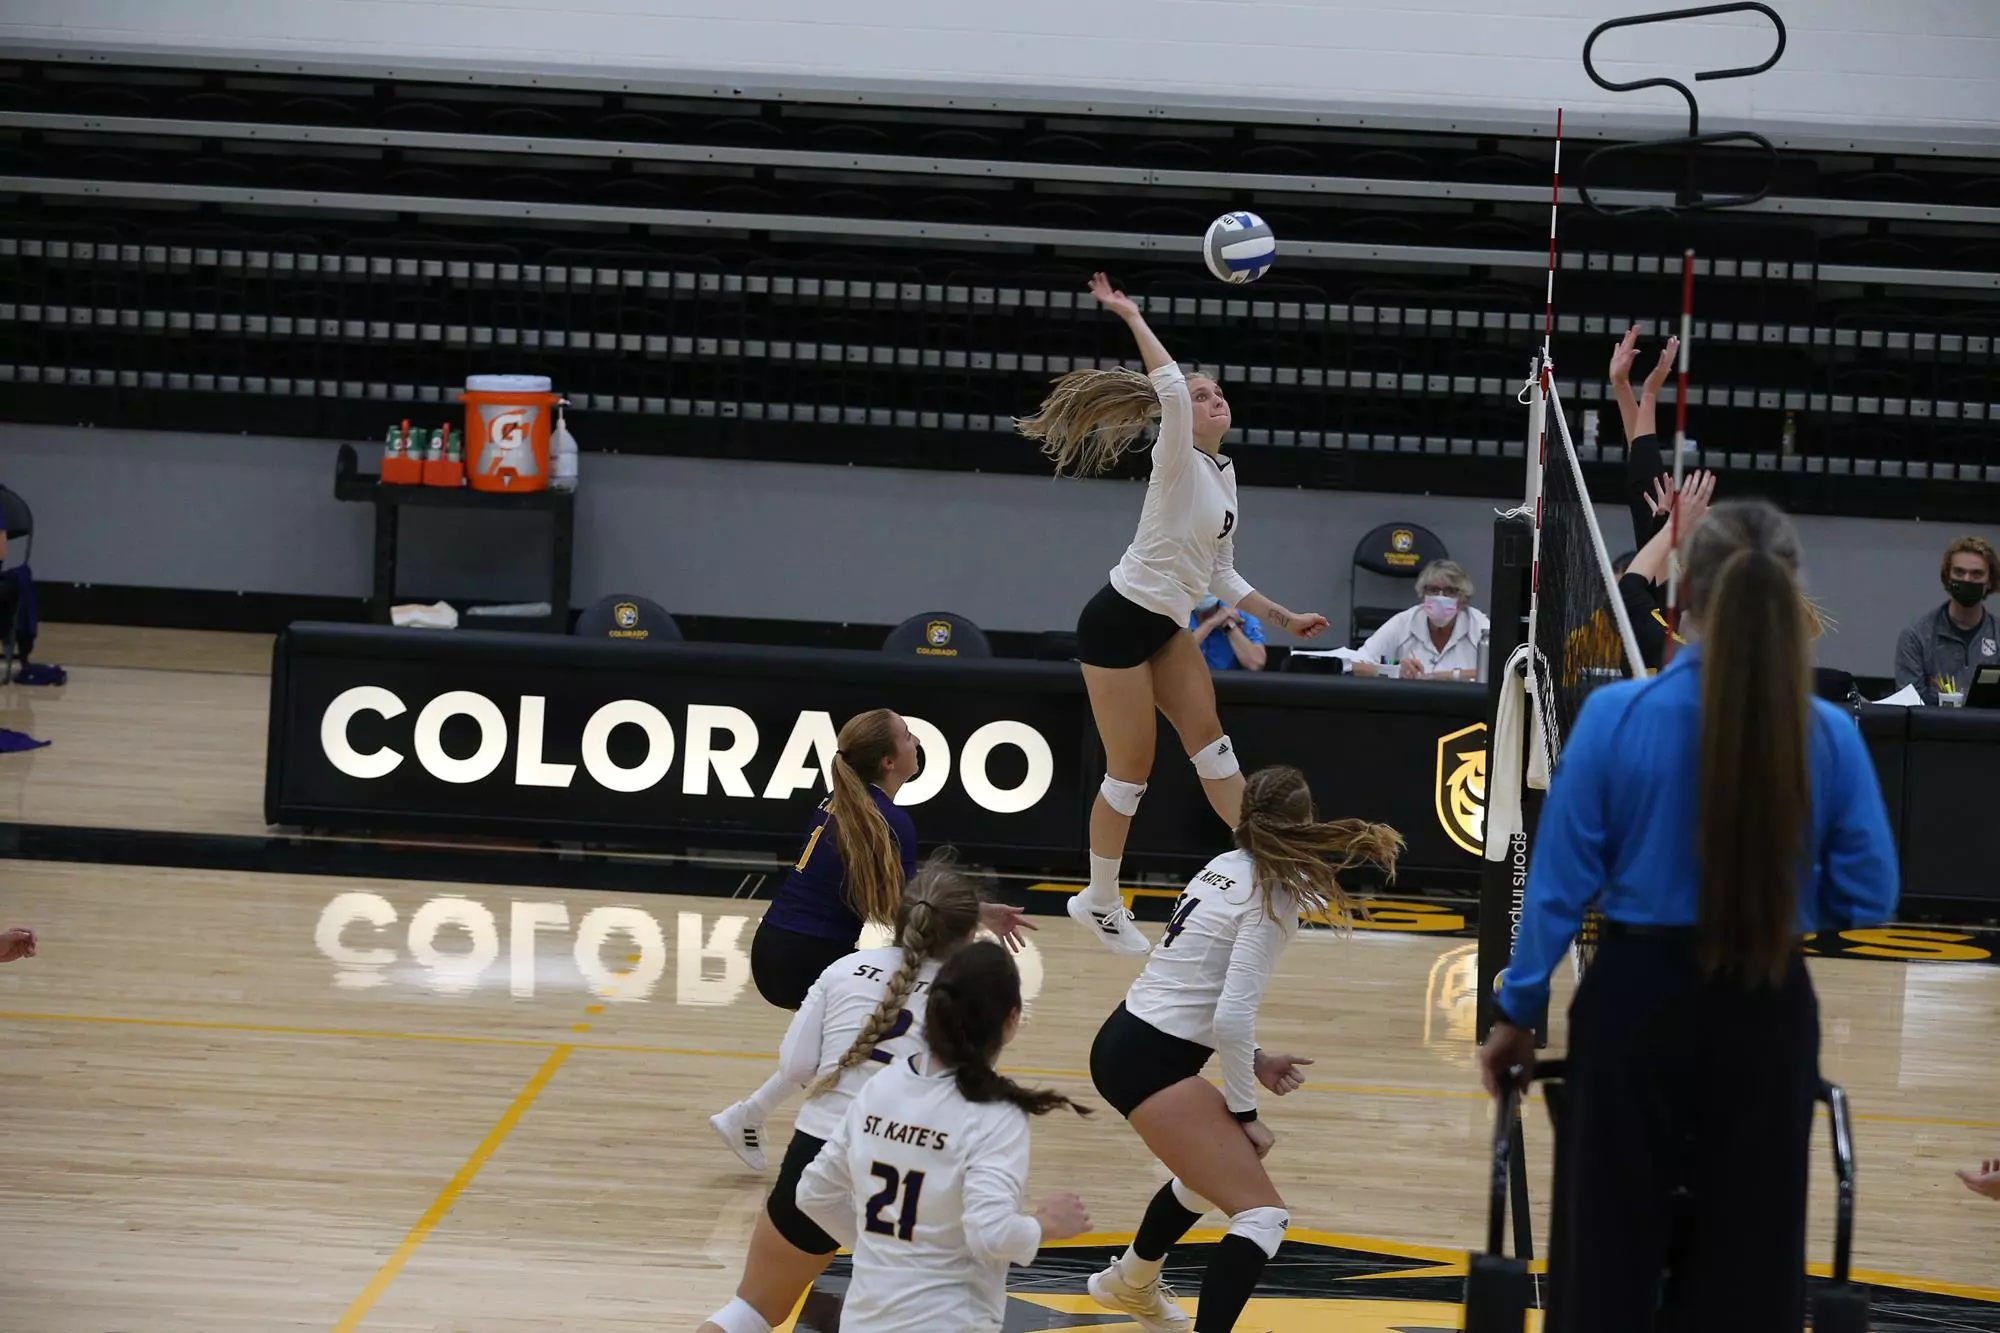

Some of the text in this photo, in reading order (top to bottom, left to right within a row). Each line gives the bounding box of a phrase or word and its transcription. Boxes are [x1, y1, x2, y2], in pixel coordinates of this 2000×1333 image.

[491, 410, 528, 450] G
[915, 647, 958, 657] COLORADO
[320, 685, 1055, 814] COLORADO
[1510, 831, 1528, 887] sports
[1199, 870, 1237, 891] KATE'S
[852, 964, 885, 982] ST.
[863, 1114, 950, 1152] ST. KATE'S
[864, 1160, 926, 1242] 21
